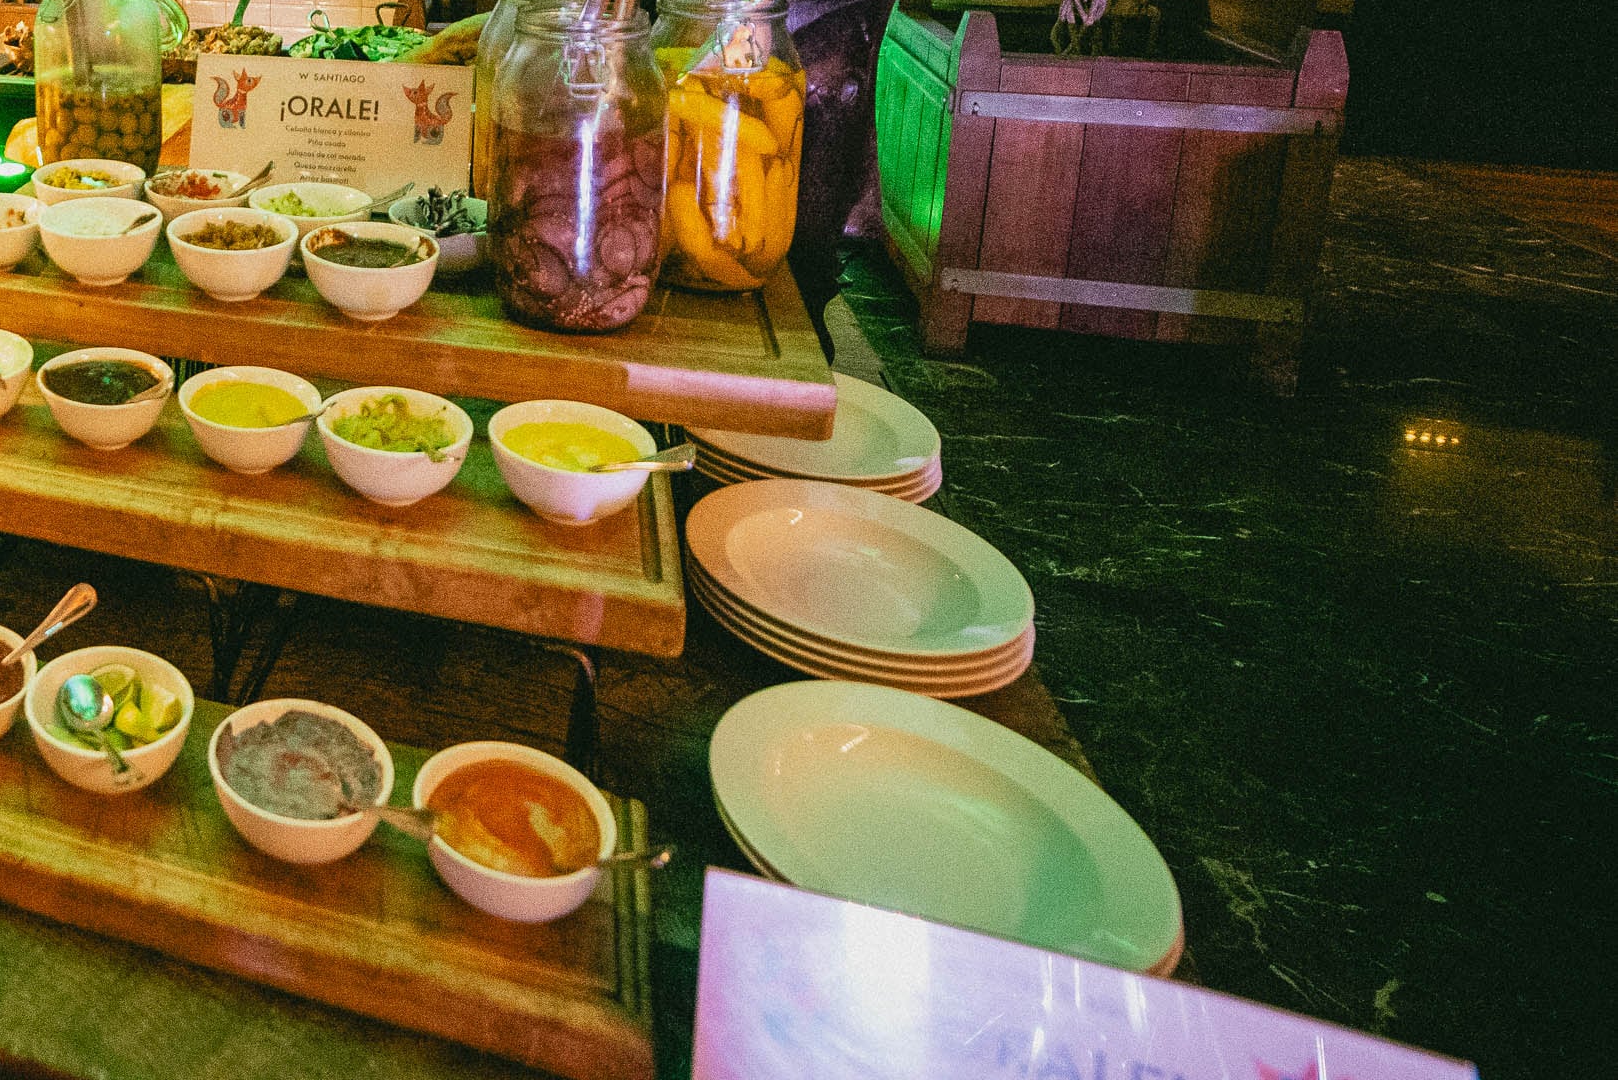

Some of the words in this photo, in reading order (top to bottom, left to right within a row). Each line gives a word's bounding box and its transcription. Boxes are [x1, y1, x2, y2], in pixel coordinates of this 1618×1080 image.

[314, 73, 366, 83] SANTIAGO
[280, 95, 379, 122] ¡ORALE!
[313, 126, 337, 135] blanca
[324, 140, 346, 148] asada
[317, 151, 325, 159] de
[338, 153, 366, 162] morada
[293, 161, 316, 170] Queso
